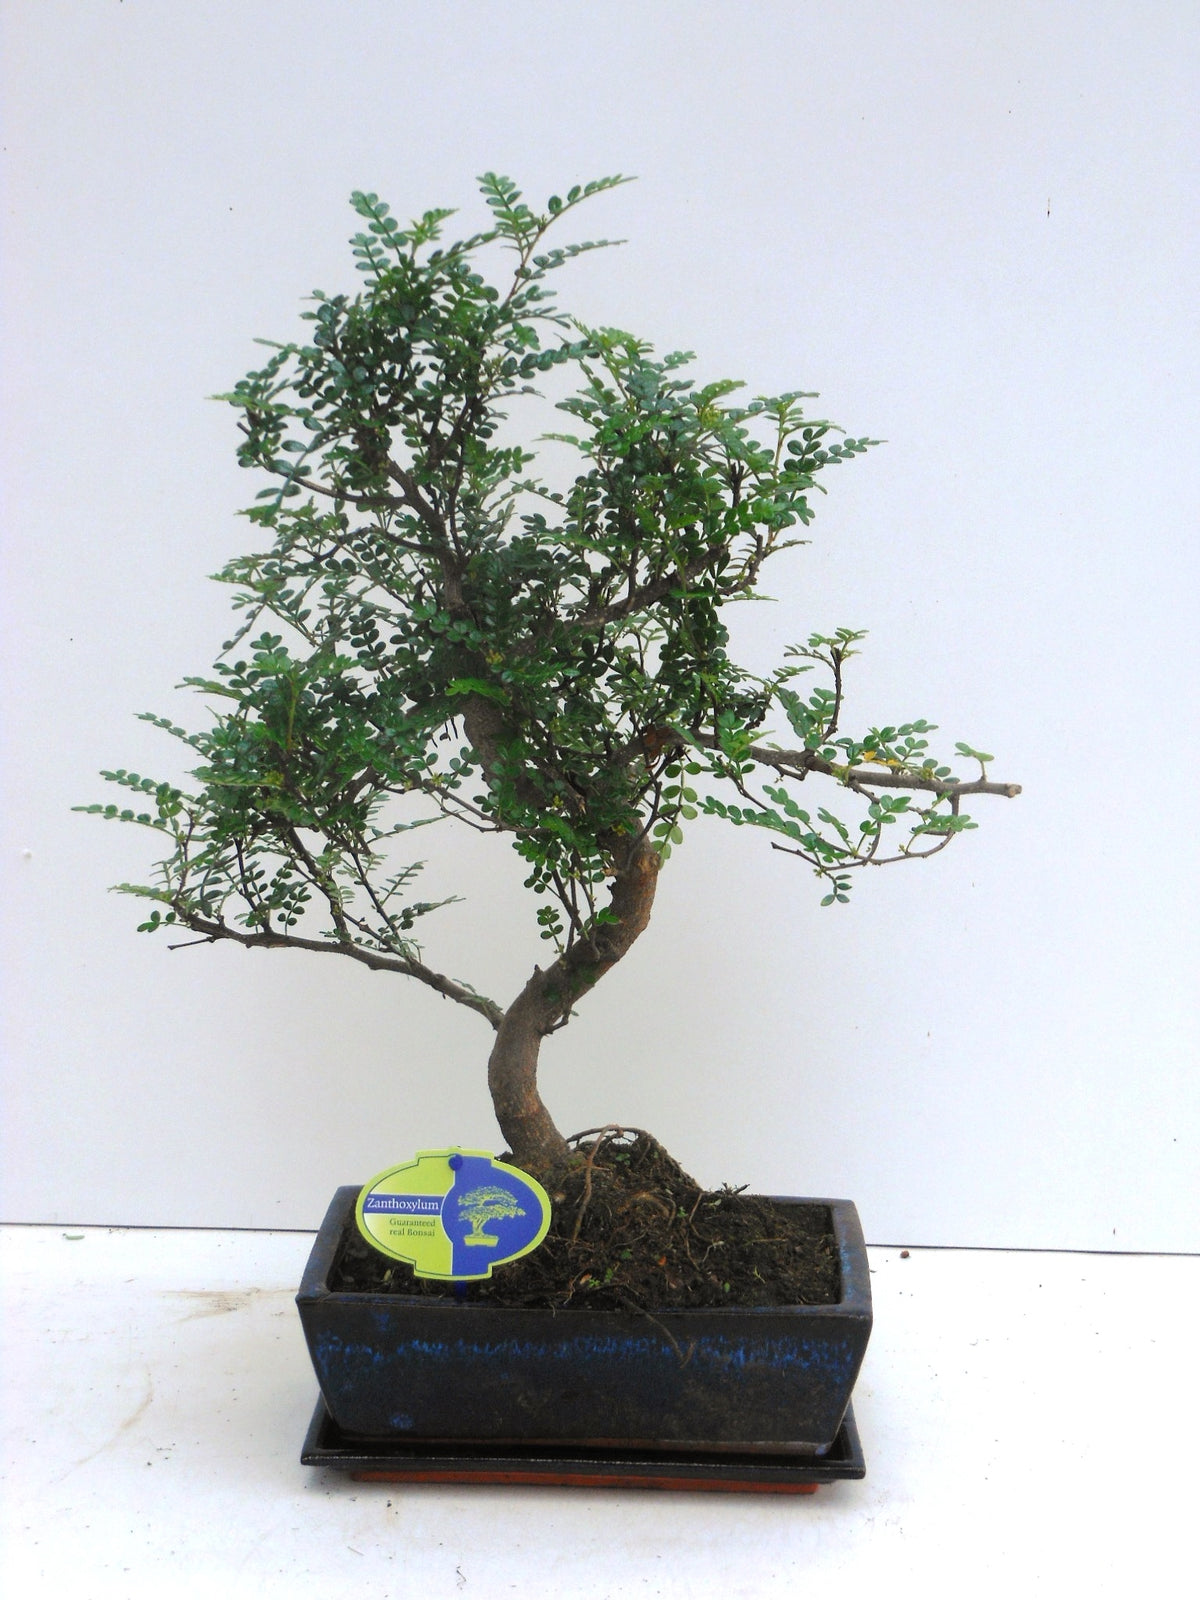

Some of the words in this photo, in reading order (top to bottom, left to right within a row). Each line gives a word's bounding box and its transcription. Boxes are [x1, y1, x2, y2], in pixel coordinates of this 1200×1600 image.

[367, 1198, 439, 1211] Zanthoxylum
[389, 1218, 436, 1227] Guaranteed
[407, 1229, 435, 1237] Bonsai
